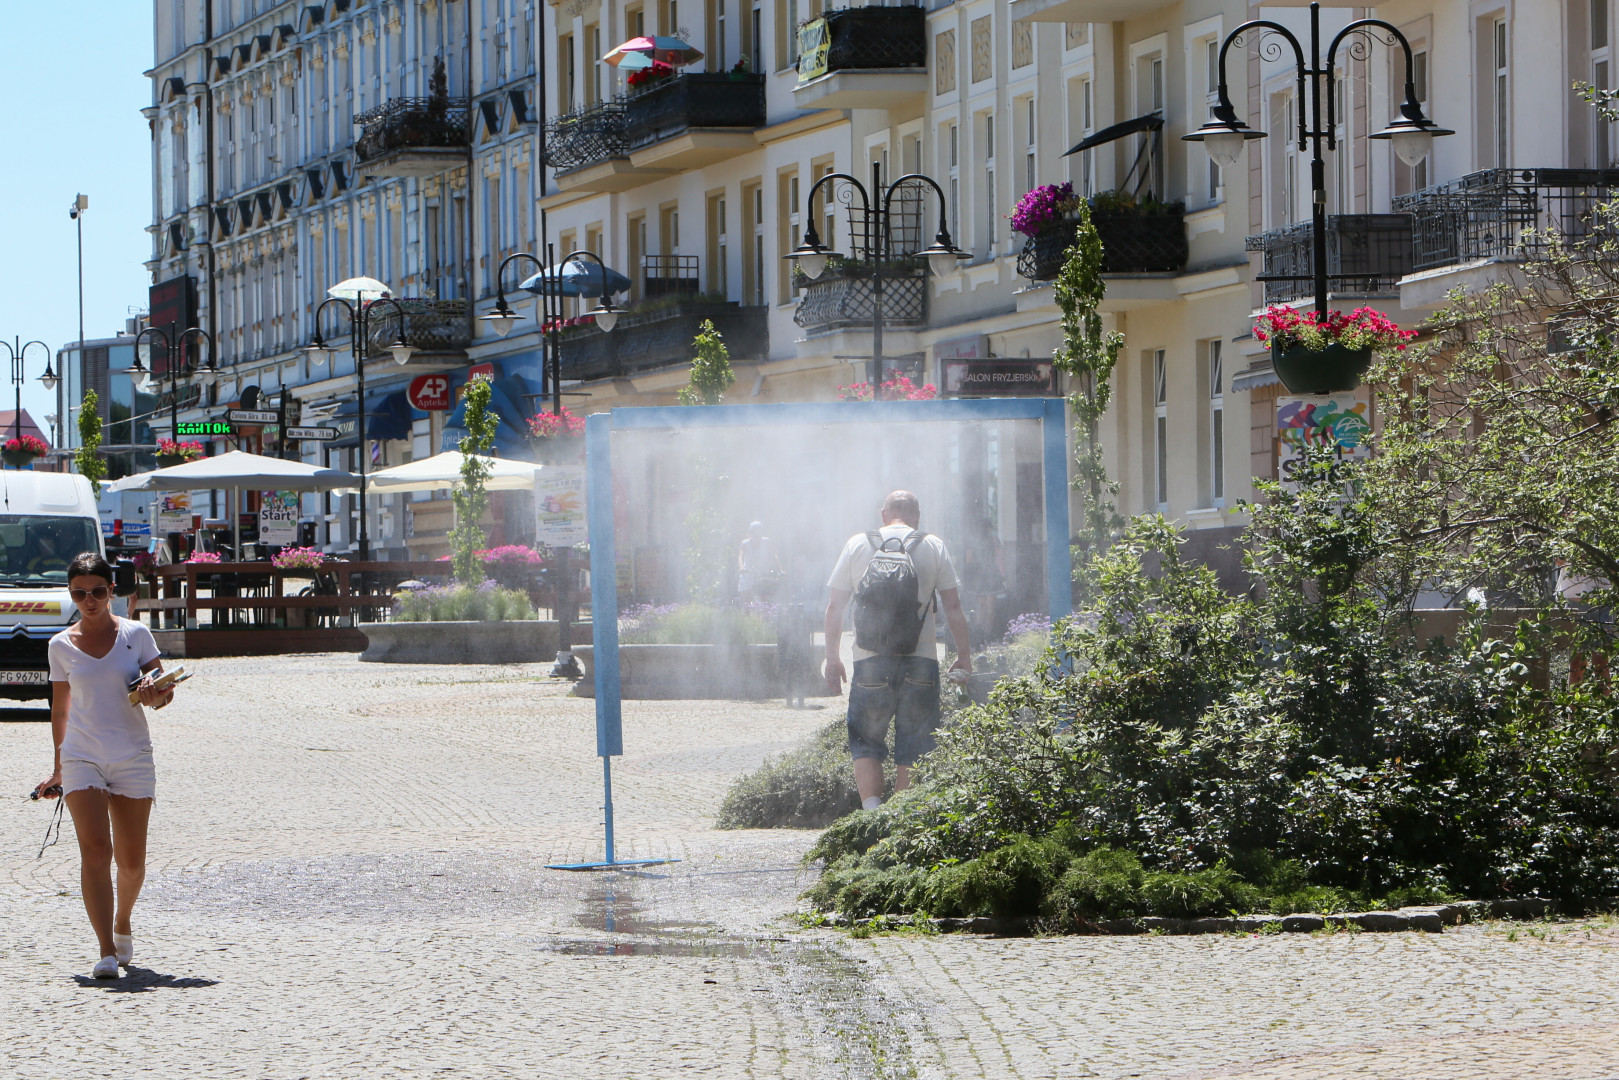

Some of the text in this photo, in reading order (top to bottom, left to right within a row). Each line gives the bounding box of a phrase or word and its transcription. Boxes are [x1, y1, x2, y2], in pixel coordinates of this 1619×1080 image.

[964, 373, 990, 382] SALON
[417, 399, 448, 408] Apteka
[231, 411, 247, 419] Zielona
[248, 412, 259, 420] Góra
[261, 510, 291, 521] Start
[16, 672, 46, 682] 9679L
